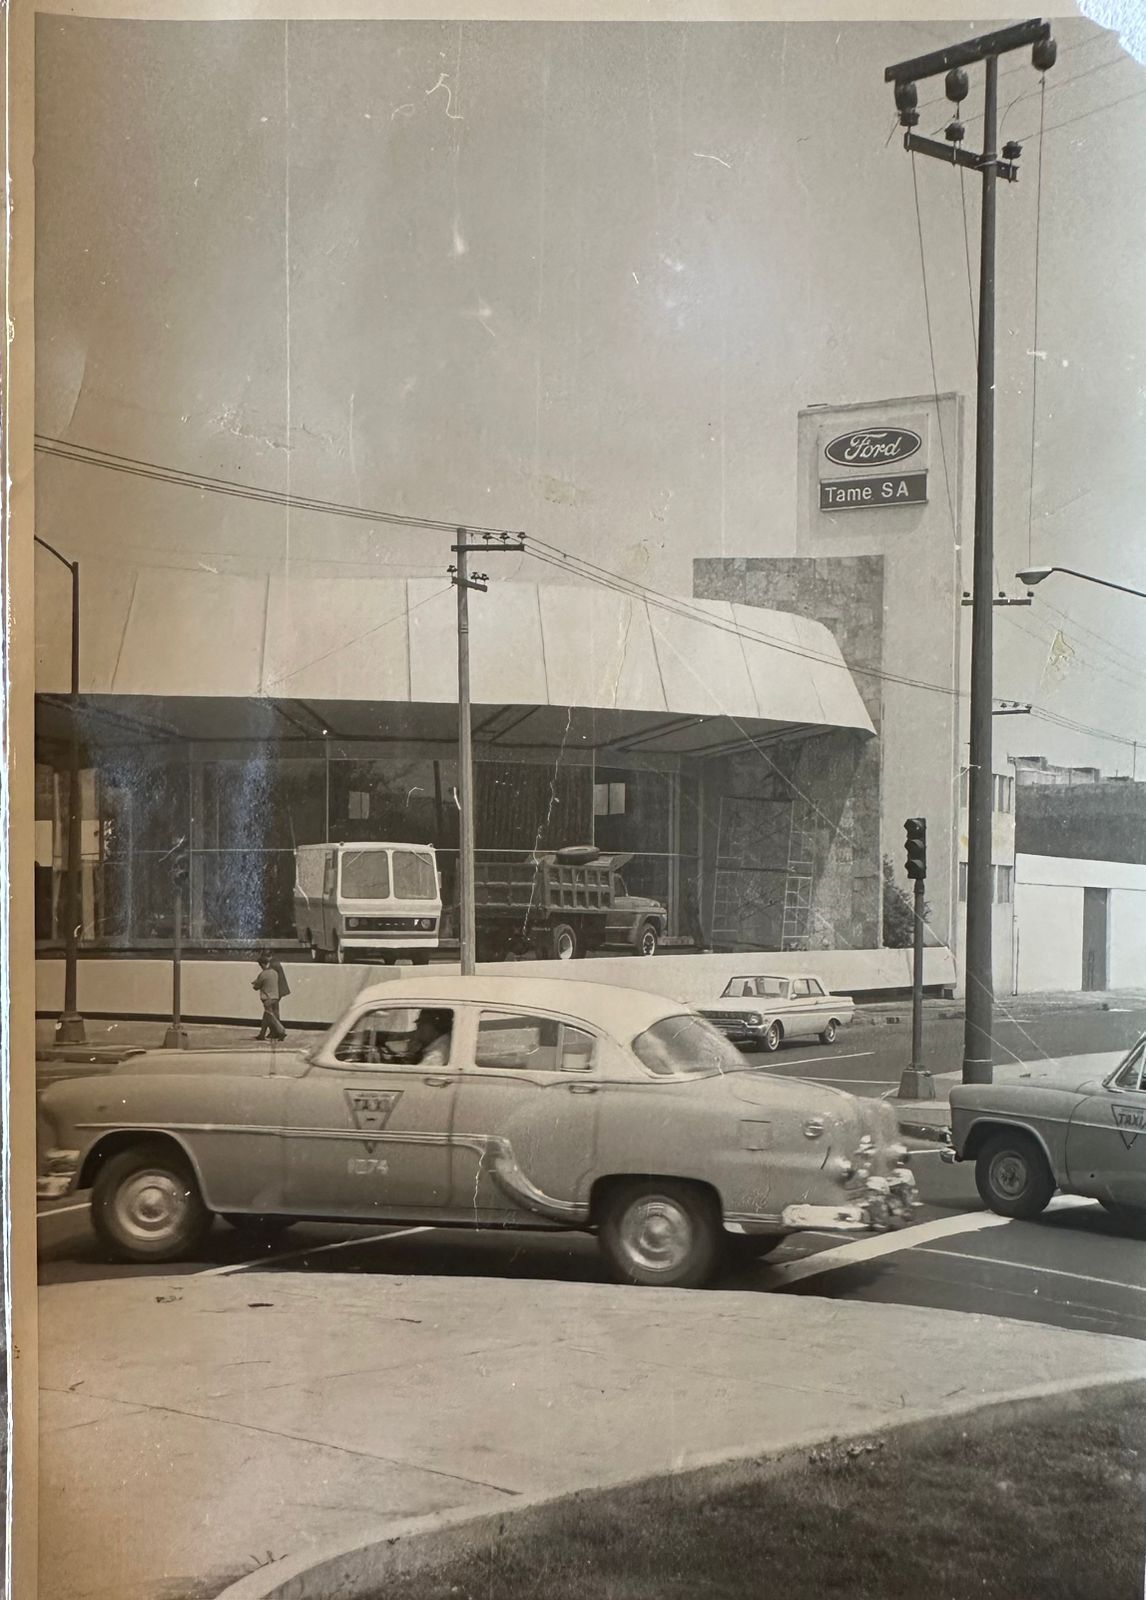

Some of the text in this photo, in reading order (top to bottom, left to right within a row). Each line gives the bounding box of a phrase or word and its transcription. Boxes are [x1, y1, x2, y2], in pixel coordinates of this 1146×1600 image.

[844, 432, 902, 461] Ford
[824, 480, 909, 503] Tame SA
